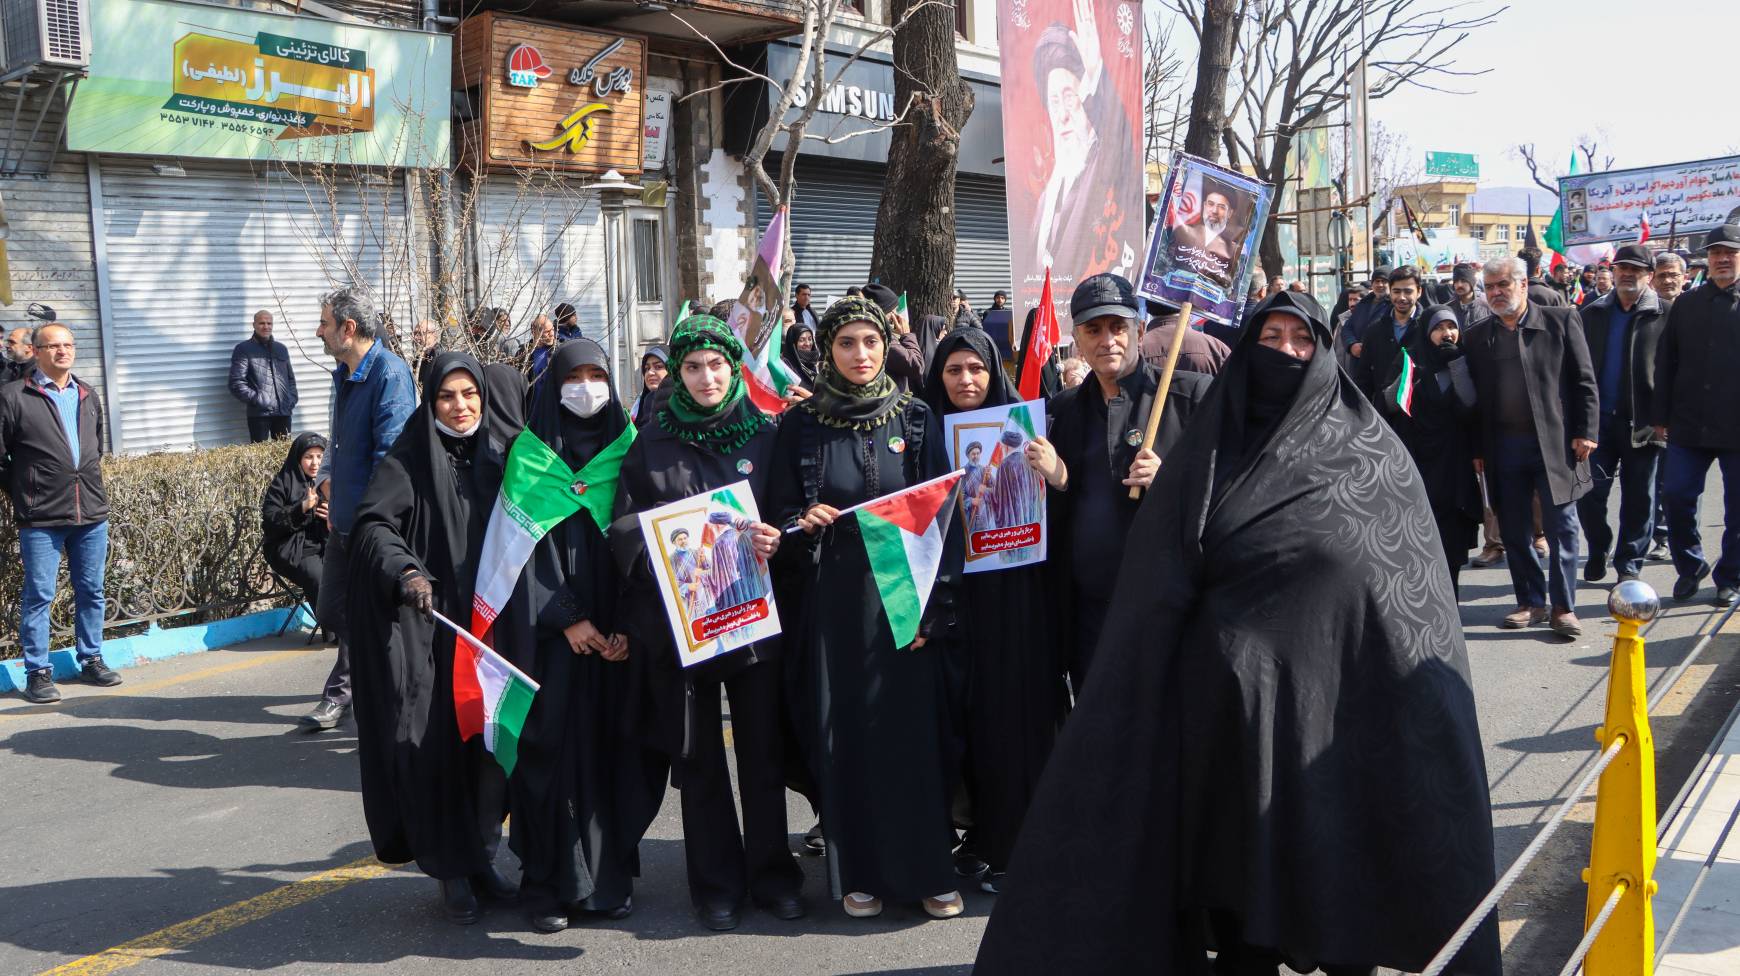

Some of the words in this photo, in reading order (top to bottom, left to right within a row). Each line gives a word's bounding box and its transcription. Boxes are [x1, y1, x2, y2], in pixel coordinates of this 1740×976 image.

[276, 41, 318, 60] تزئینی
[318, 46, 350, 63] کالای
[182, 58, 247, 87] (لطیفی)
[510, 71, 537, 86] TAK
[246, 57, 371, 114] البرز
[593, 66, 633, 98] بورس
[179, 99, 210, 113] پارکت
[209, 105, 216, 113] و
[217, 103, 255, 118] کفپوش
[1708, 172, 1725, 185] سال
[1620, 181, 1649, 195] اسرائیل
[1653, 192, 1684, 207] اسرائیل
